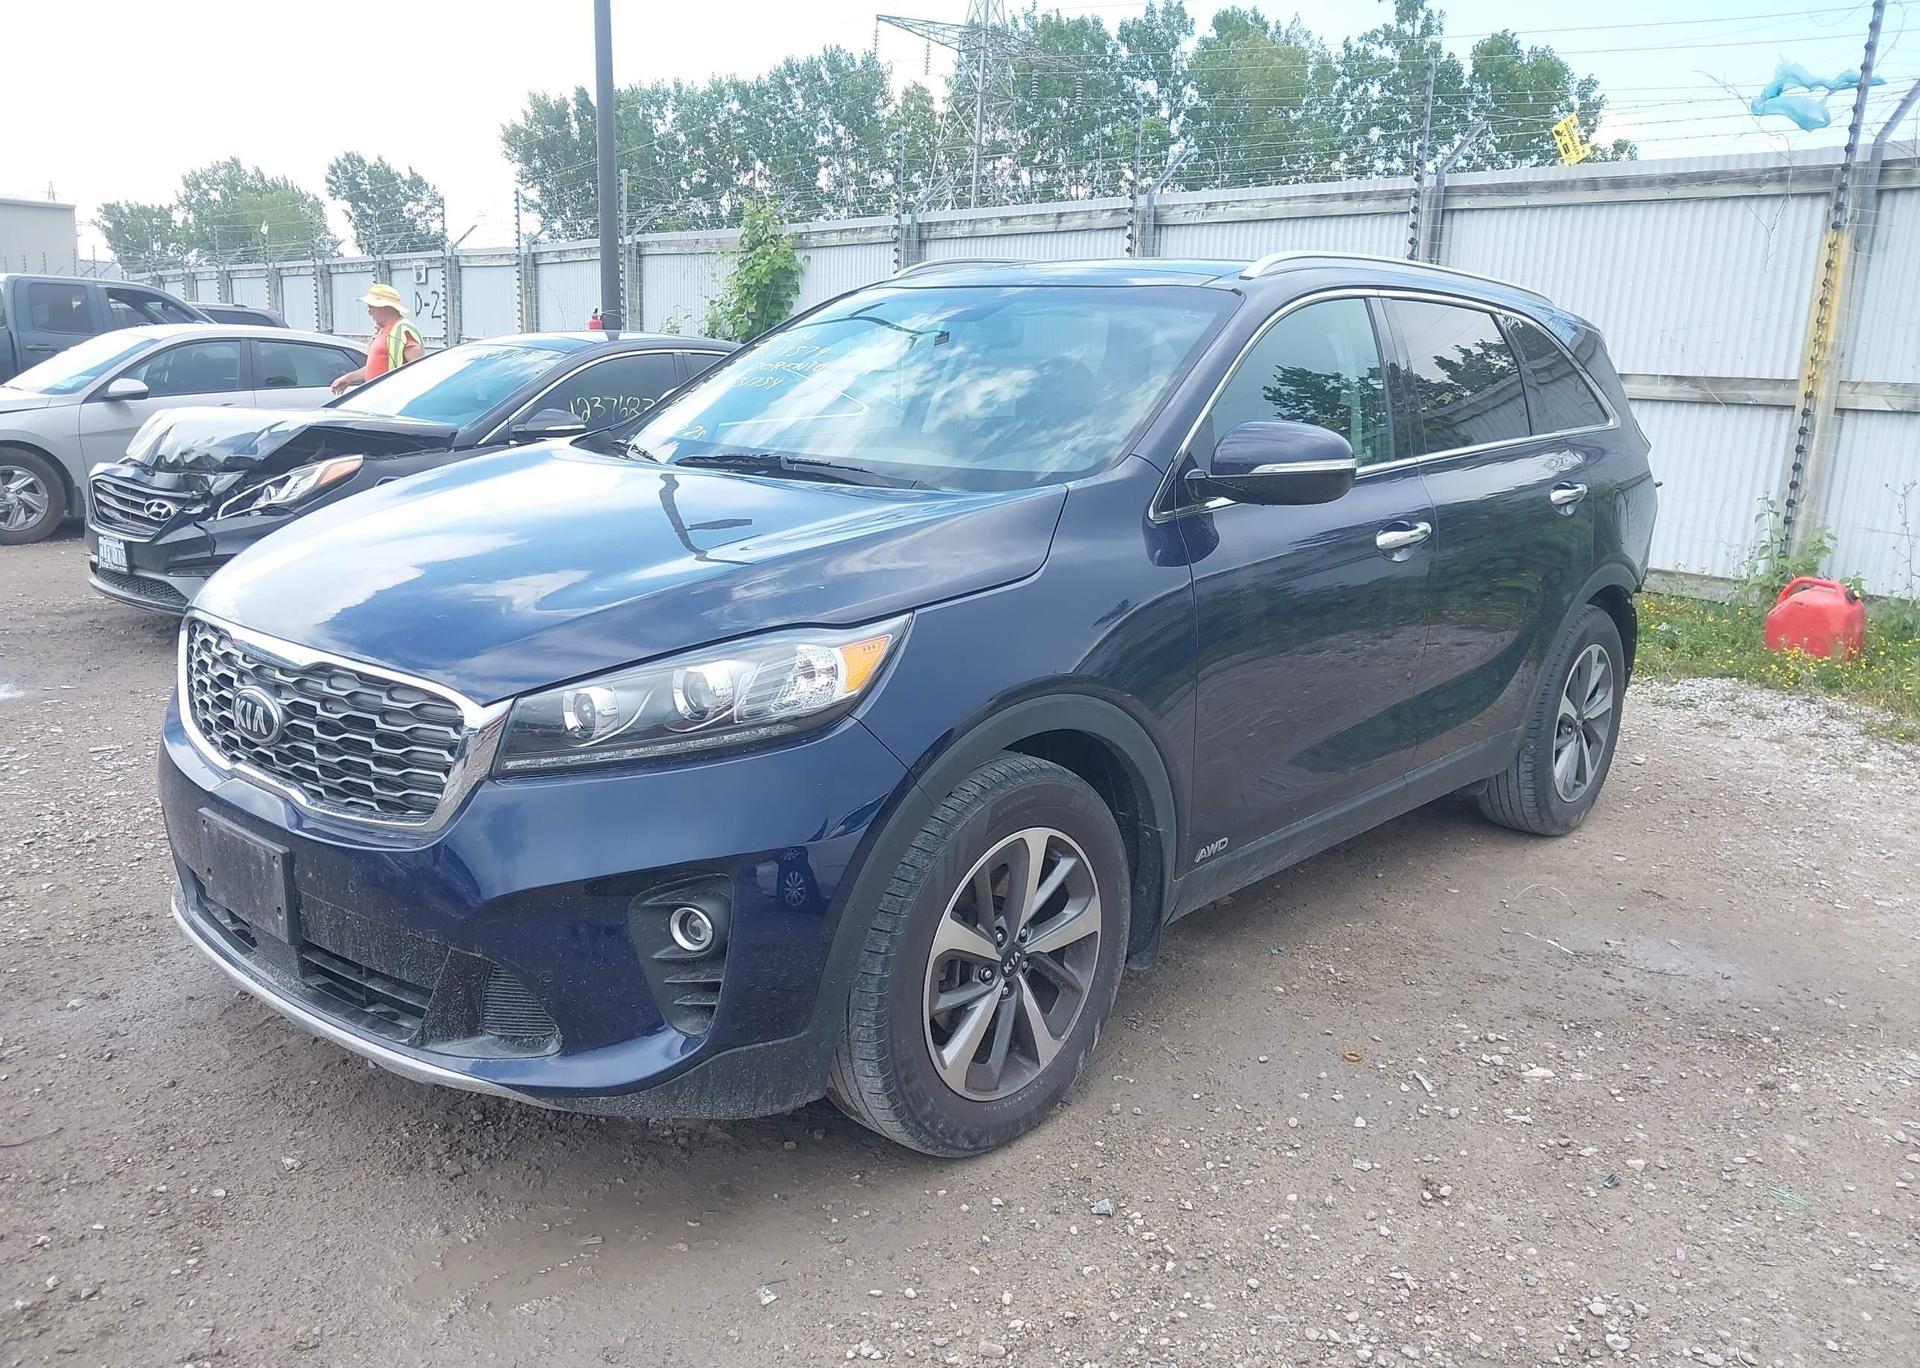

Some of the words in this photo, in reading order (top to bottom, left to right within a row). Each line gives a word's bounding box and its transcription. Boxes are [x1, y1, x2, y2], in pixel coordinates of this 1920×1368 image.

[415, 290, 442, 319] D-2
[235, 697, 268, 736] KIA
[1194, 836, 1229, 864] AWD
[1003, 951, 1021, 974] KIA
